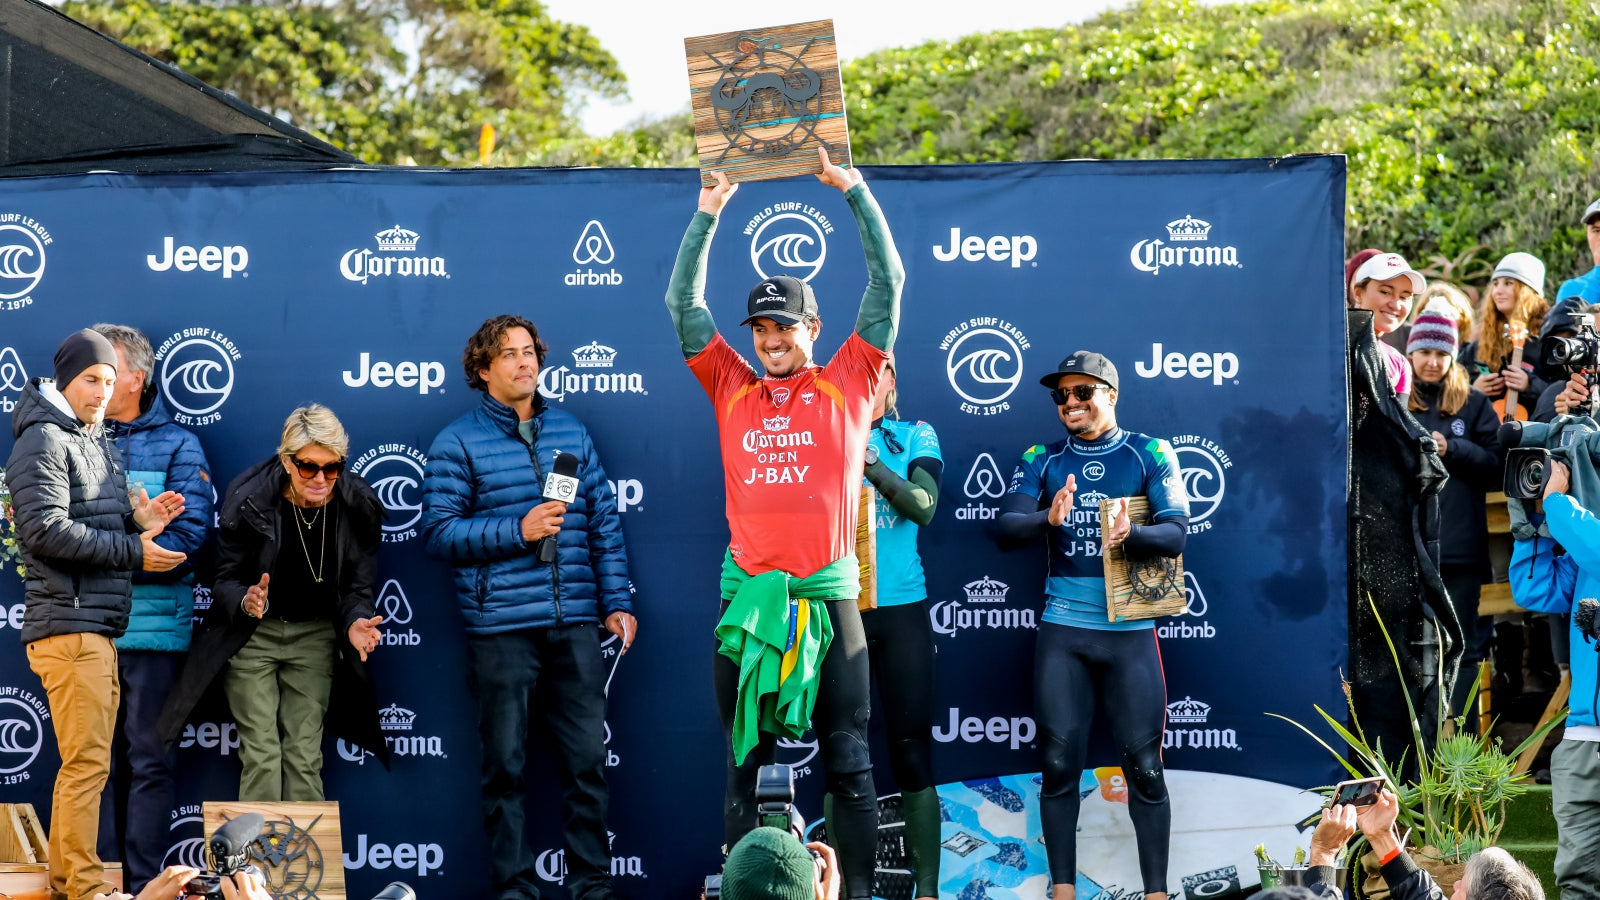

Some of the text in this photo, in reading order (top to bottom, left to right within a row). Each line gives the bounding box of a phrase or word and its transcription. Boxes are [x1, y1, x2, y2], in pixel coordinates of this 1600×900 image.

[0, 213, 53, 246] URF LEAGUE
[742, 201, 835, 236] WORLD SURF LEAGUE
[147, 237, 249, 278] Jeep
[933, 228, 1038, 268] Jeep
[1130, 239, 1240, 275] Corona
[340, 248, 447, 285] Corona
[564, 269, 623, 286] airbnb
[7, 296, 33, 311] 1976
[154, 328, 242, 362] WORLD SURF LEAGUE
[939, 316, 1031, 351] WORLD SURF LEAGUE
[342, 352, 446, 395] Jeep
[1135, 343, 1240, 385] Jeep
[537, 365, 645, 402] Corona
[174, 411, 222, 425] EST. 1976
[960, 401, 1011, 415] EST. 1976
[378, 443, 406, 454] SURF
[742, 429, 814, 454] Corona
[758, 451, 798, 463] OPEN
[1172, 435, 1233, 469] SURF LEAGUE
[744, 465, 811, 485] J-BAY
[390, 529, 417, 543] 1976
[1077, 527, 1102, 537] OPE
[1186, 520, 1212, 535] 1976
[929, 600, 1037, 637] Corona
[1157, 621, 1216, 639] airbnb
[379, 628, 420, 646] rbnb
[20, 689, 51, 721] LEAGUE
[179, 722, 241, 756] eep
[931, 707, 1037, 749] Jeep
[1161, 728, 1238, 749] orona
[4, 771, 31, 785] 1976
[793, 766, 812, 780] 976
[343, 834, 444, 876] Jeep
